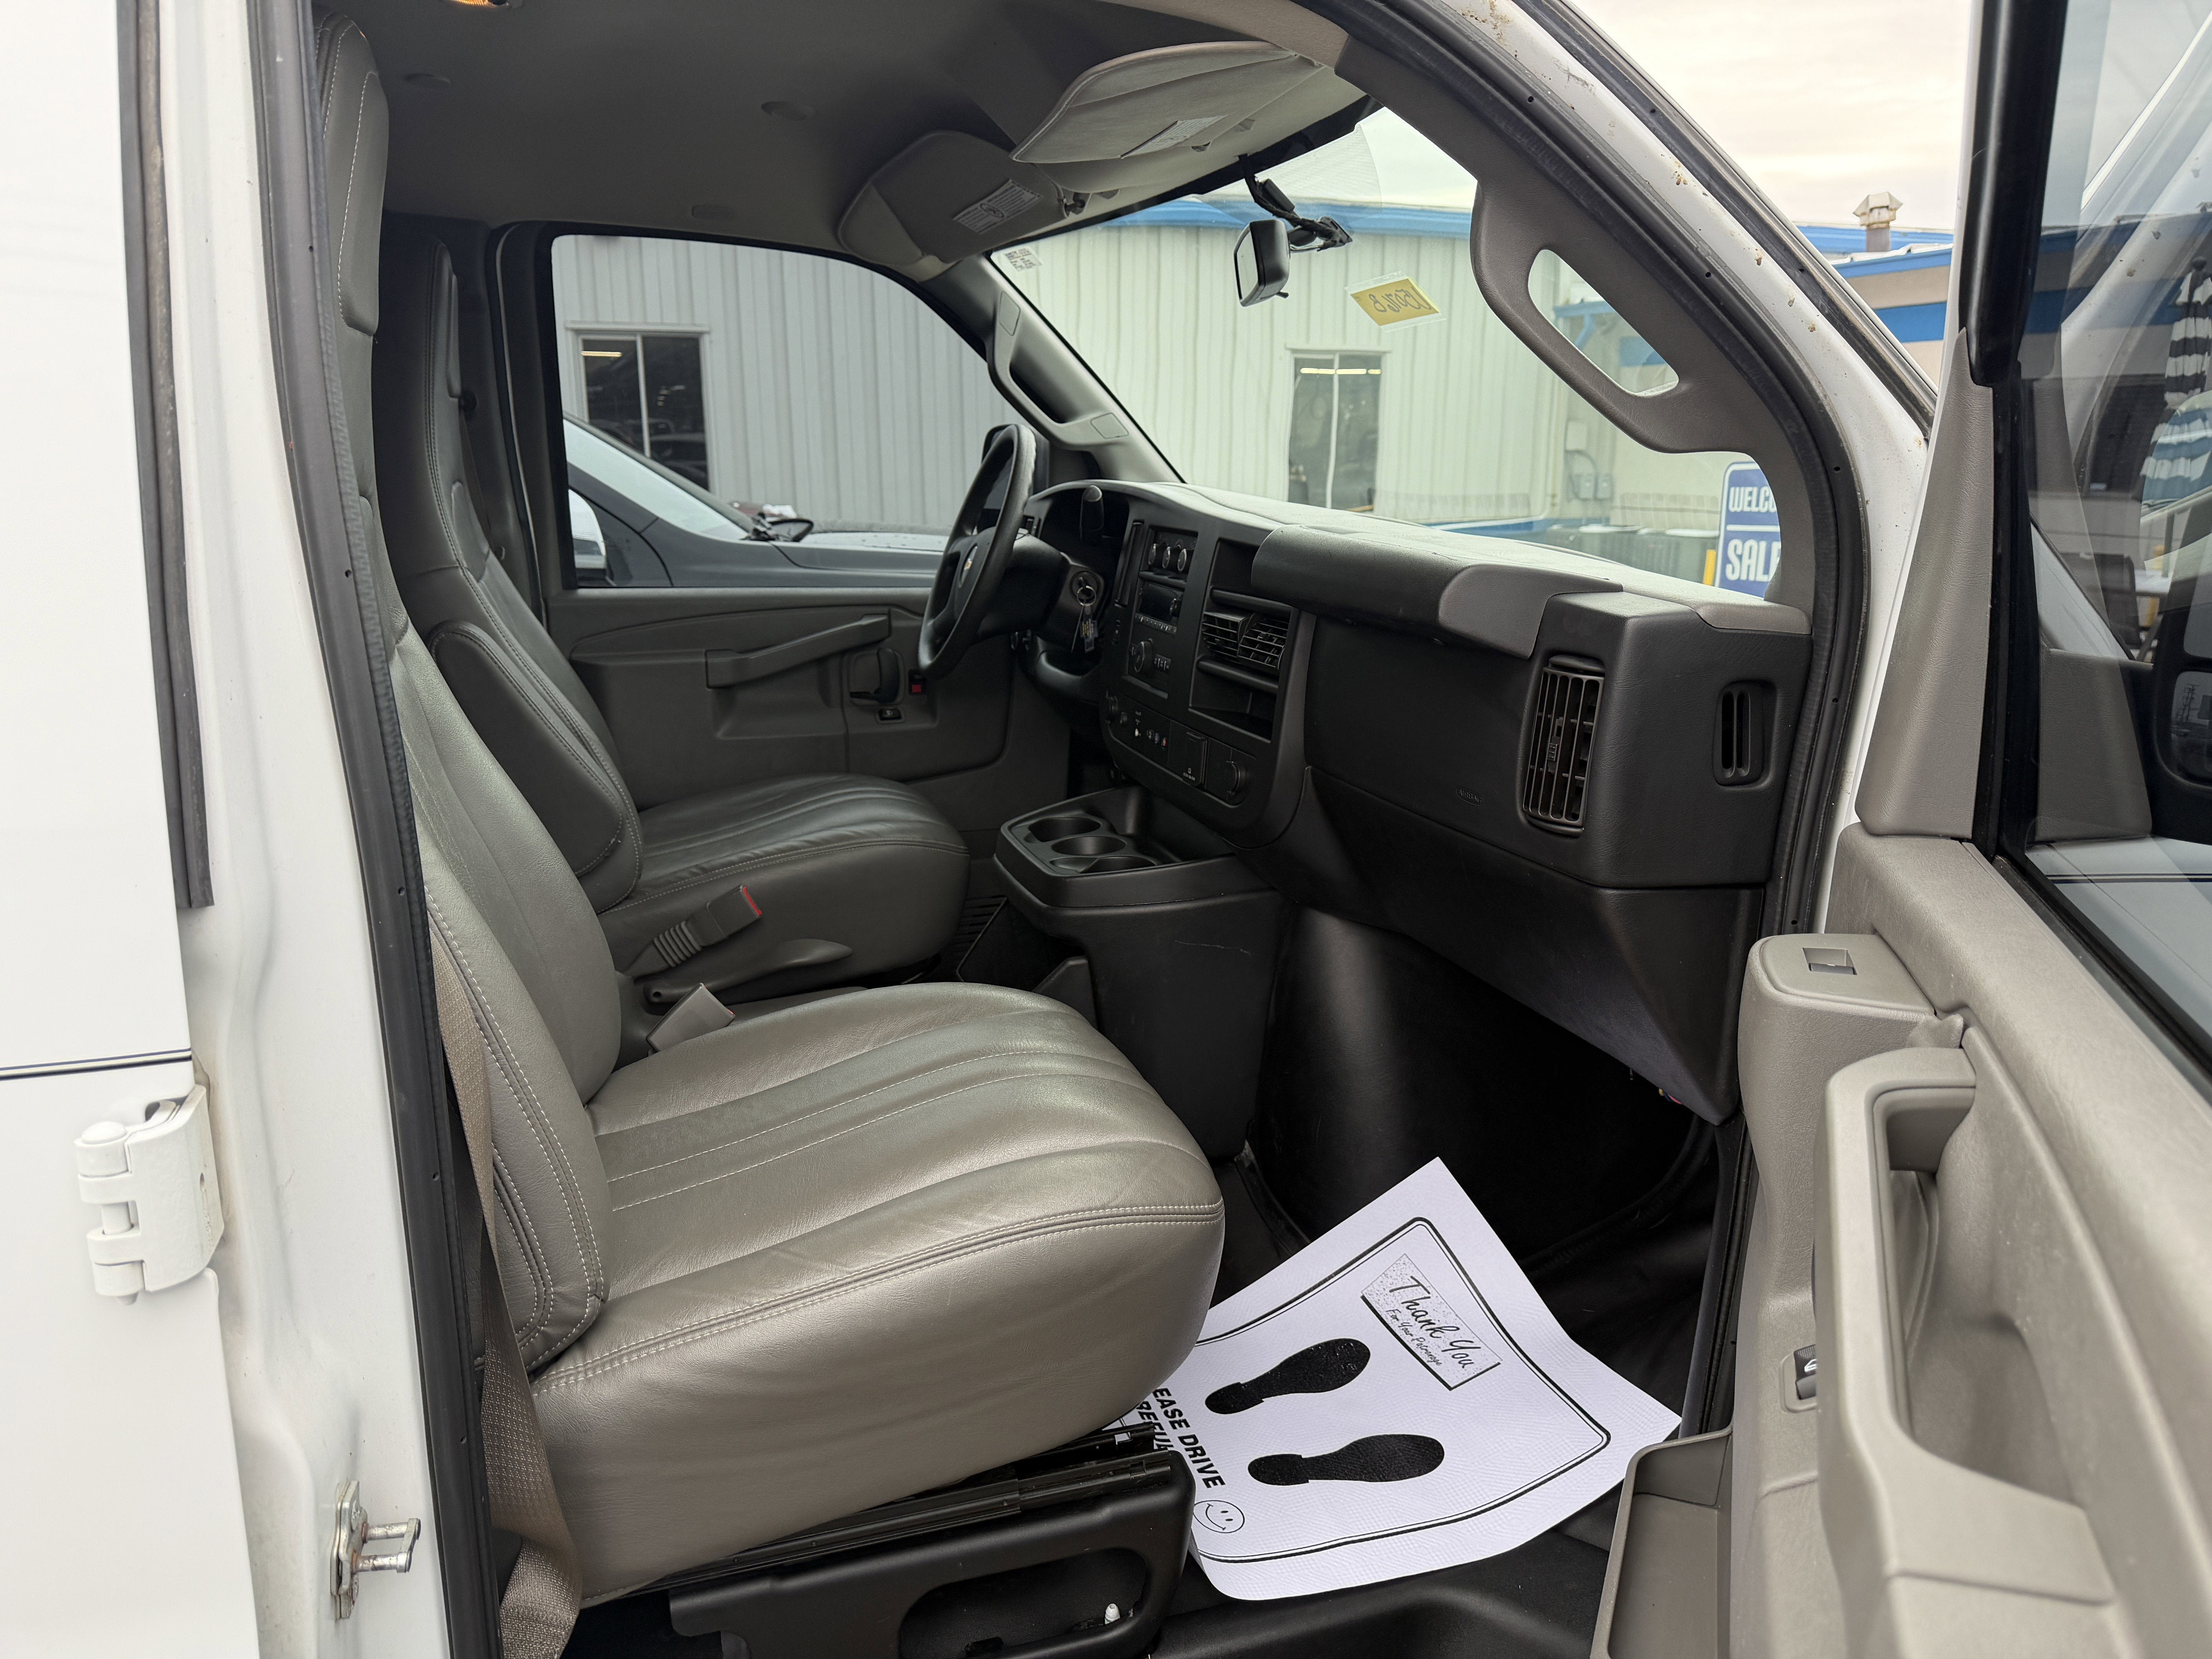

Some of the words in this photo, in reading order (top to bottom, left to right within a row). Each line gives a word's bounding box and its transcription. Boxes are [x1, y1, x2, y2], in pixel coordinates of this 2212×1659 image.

[1385, 1309, 1401, 1321] For
[1398, 1322, 1413, 1337] Your
[1411, 1337, 1443, 1366] Patronage
[1389, 1276, 1460, 1338] Thank
[1441, 1340, 1481, 1369] You
[1152, 1388, 1191, 1430] EASE
[1177, 1434, 1226, 1489] DRIVE
